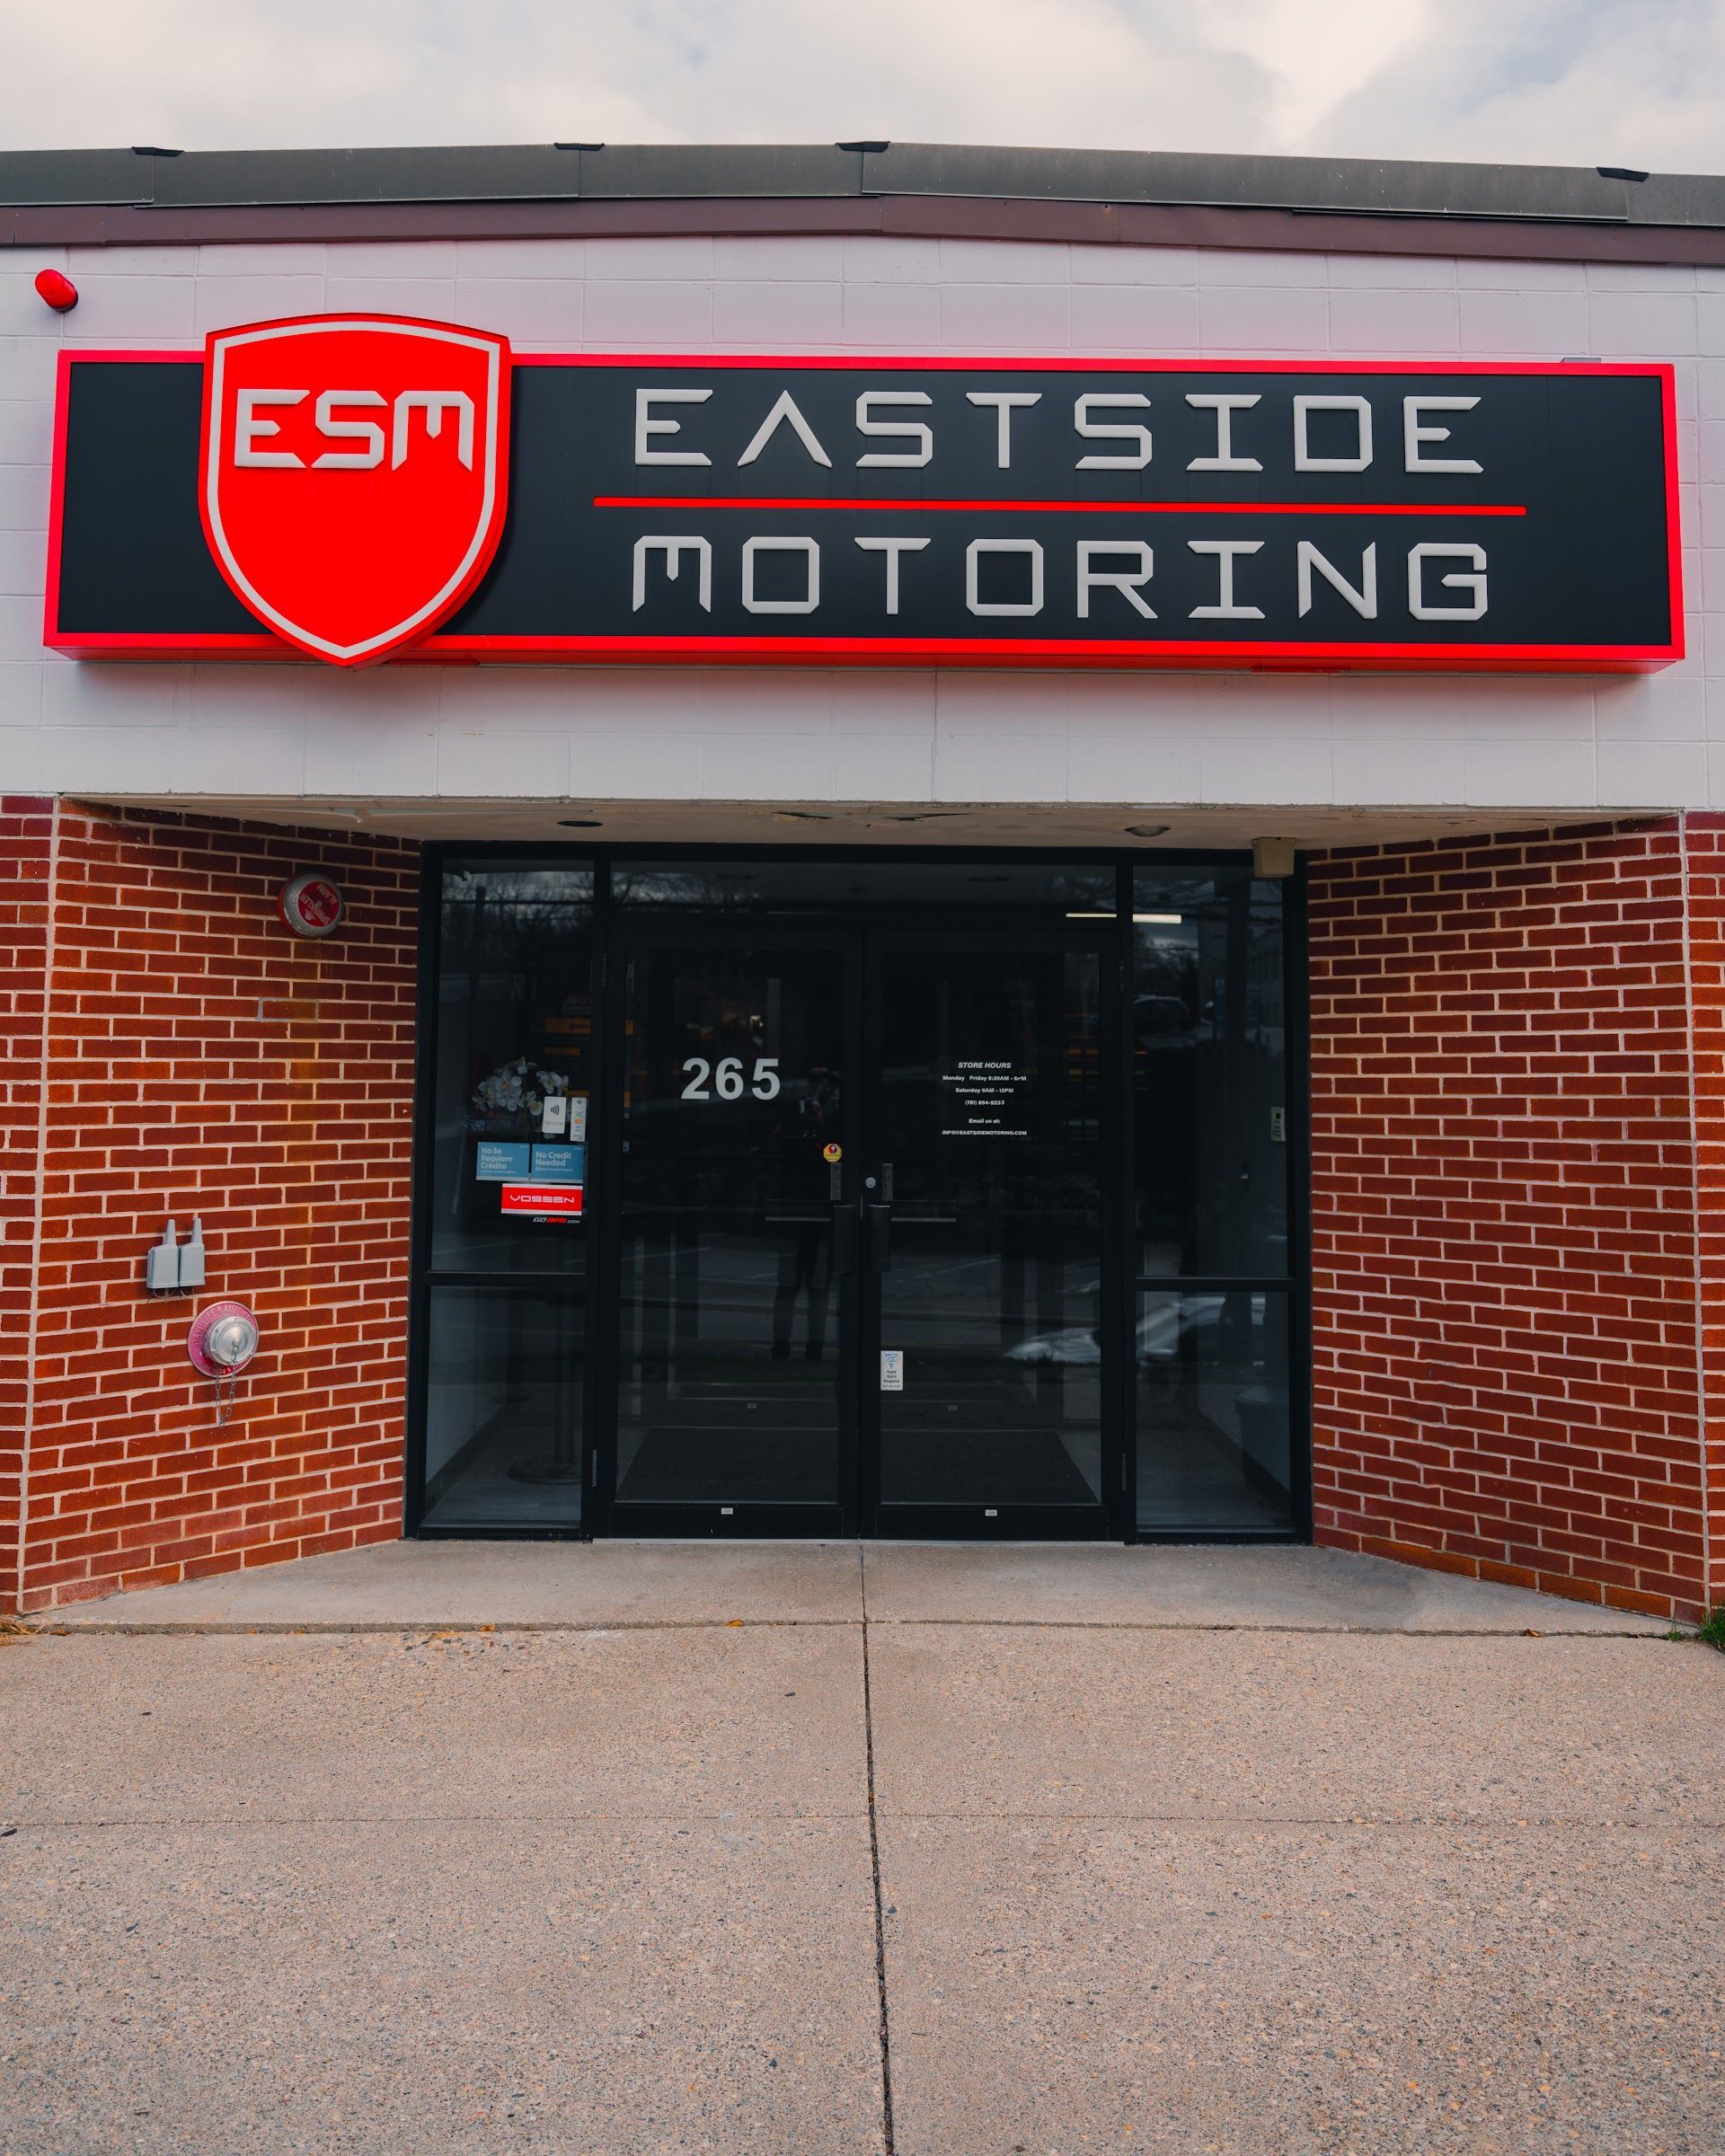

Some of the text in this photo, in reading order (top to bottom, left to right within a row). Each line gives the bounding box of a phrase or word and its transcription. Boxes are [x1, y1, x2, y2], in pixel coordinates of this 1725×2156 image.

[234, 388, 475, 472] ESM
[634, 388, 1484, 474] EASTSIDE
[632, 535, 1490, 622] MOTORING
[316, 882, 339, 905] ALARM
[299, 893, 331, 925] SPRINKLER
[681, 1057, 781, 1100] 265
[481, 1154, 513, 1163] Requiere
[481, 1162, 508, 1171] Crédito
[535, 1159, 566, 1167] Needed
[548, 1151, 571, 1160] Credit
[509, 1195, 575, 1204] VOSSEN
